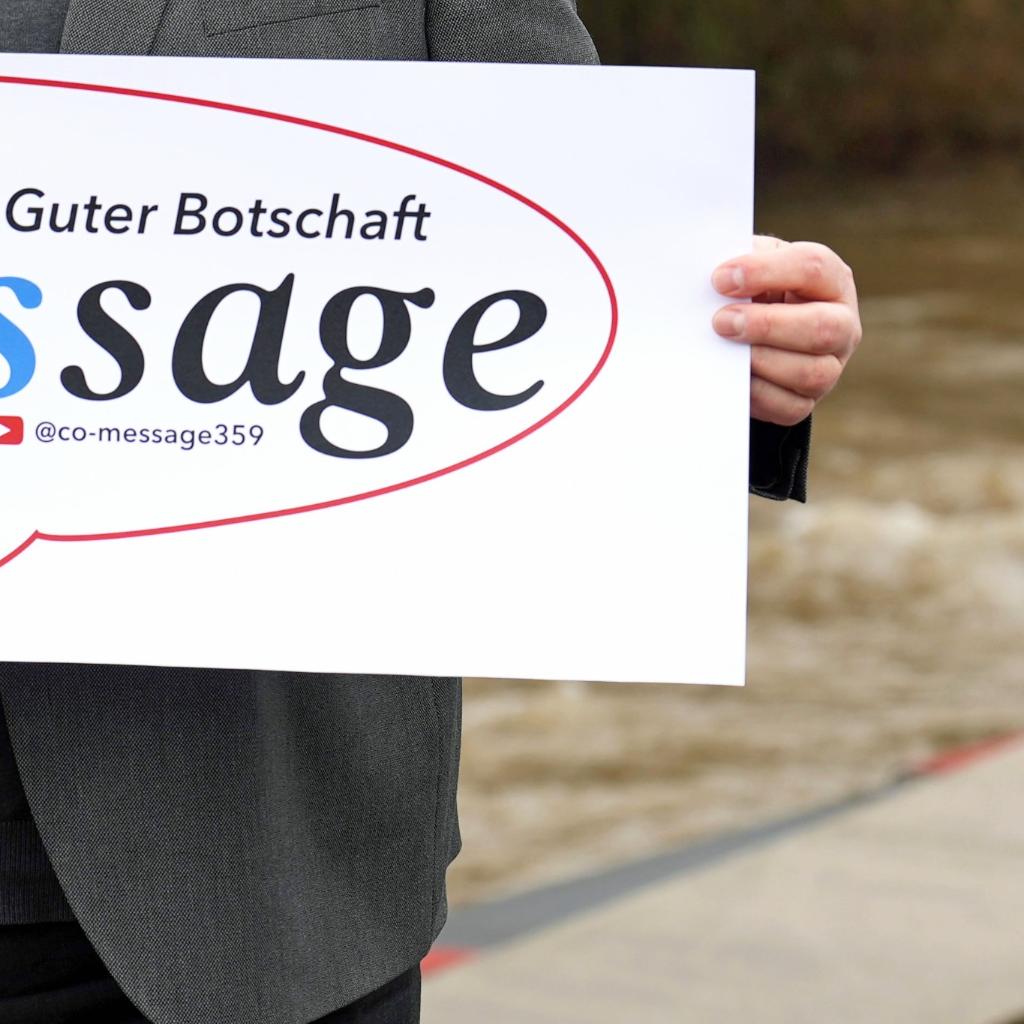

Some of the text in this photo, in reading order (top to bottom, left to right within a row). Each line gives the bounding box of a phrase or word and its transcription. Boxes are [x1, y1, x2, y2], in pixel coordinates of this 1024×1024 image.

[5, 187, 159, 236] Guter
[173, 192, 432, 242] Botschaft
[34, 420, 265, 451] @co-message359
